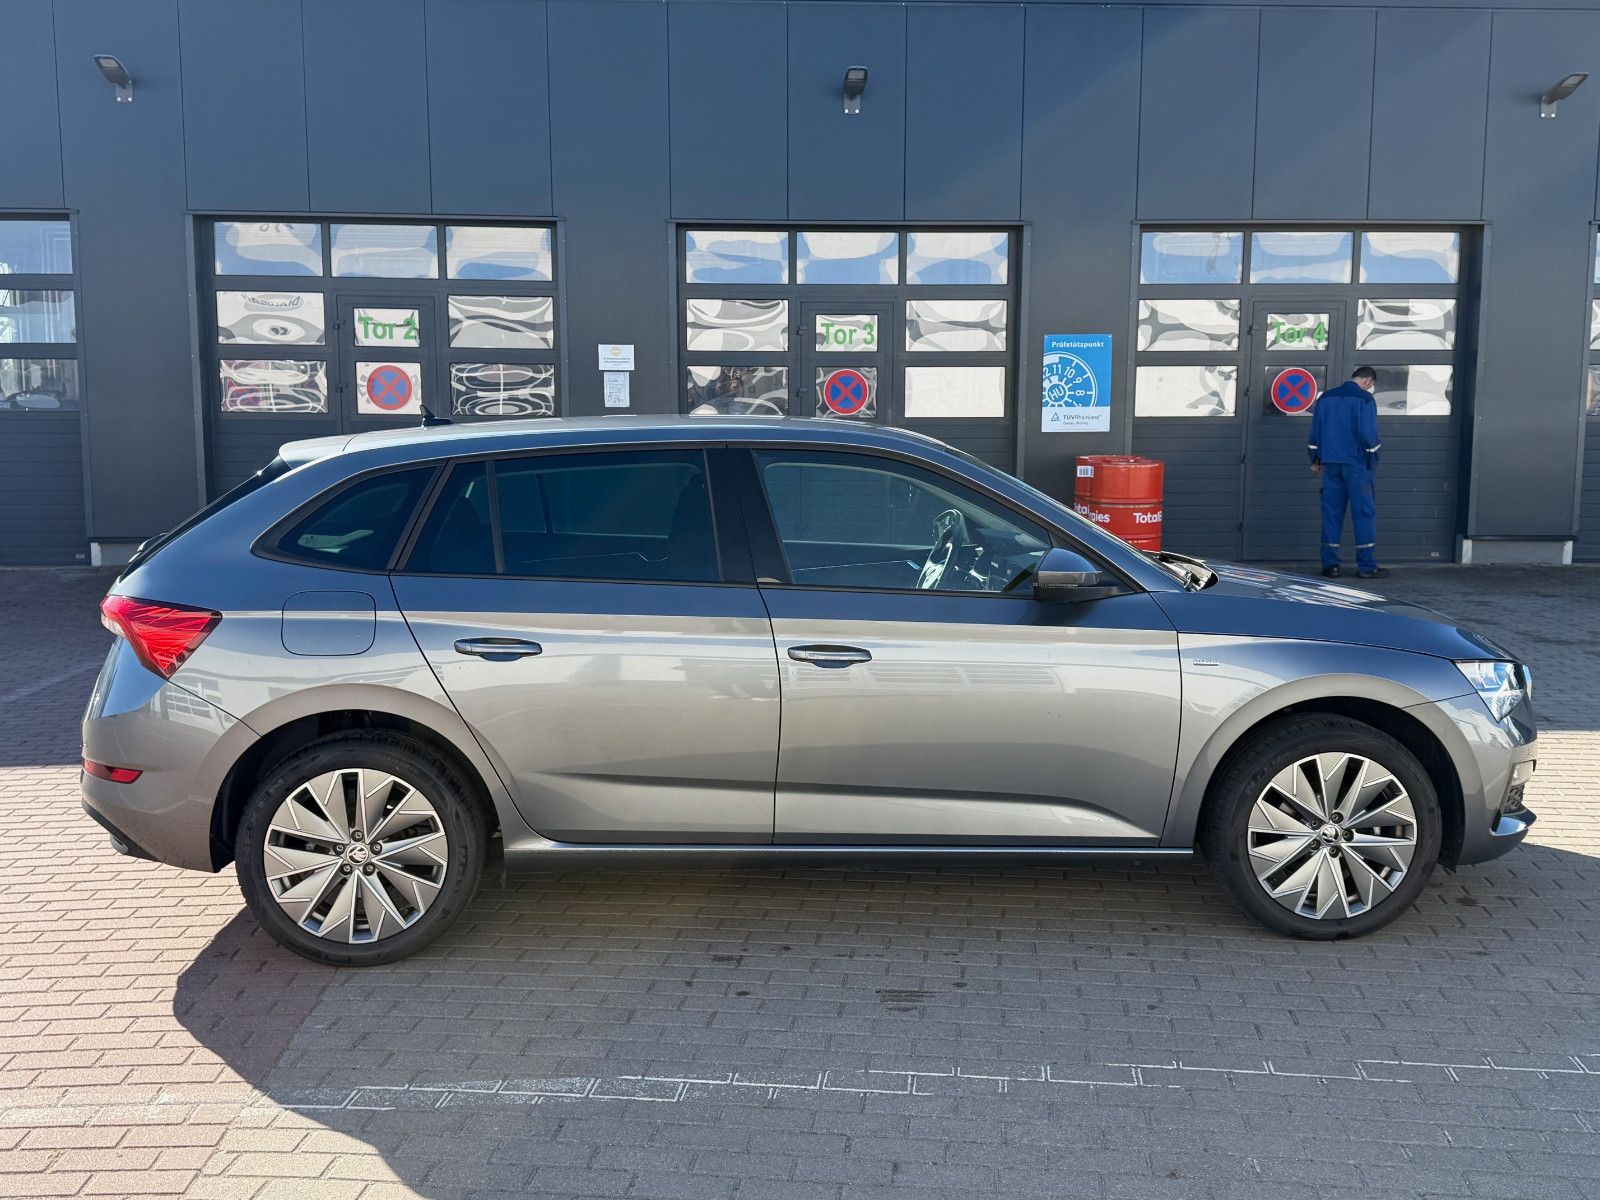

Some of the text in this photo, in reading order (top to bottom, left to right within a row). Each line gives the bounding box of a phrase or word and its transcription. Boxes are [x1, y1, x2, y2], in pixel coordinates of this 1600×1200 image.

[358, 317, 416, 339] Tor 2
[821, 322, 874, 345] Tor 3
[1272, 321, 1327, 343] Tor 4
[1042, 367, 1051, 379] 2
[1052, 364, 1062, 375] 11
[1064, 366, 1076, 379] 10
[1072, 376, 1083, 384] 9
[1049, 386, 1064, 400] HU
